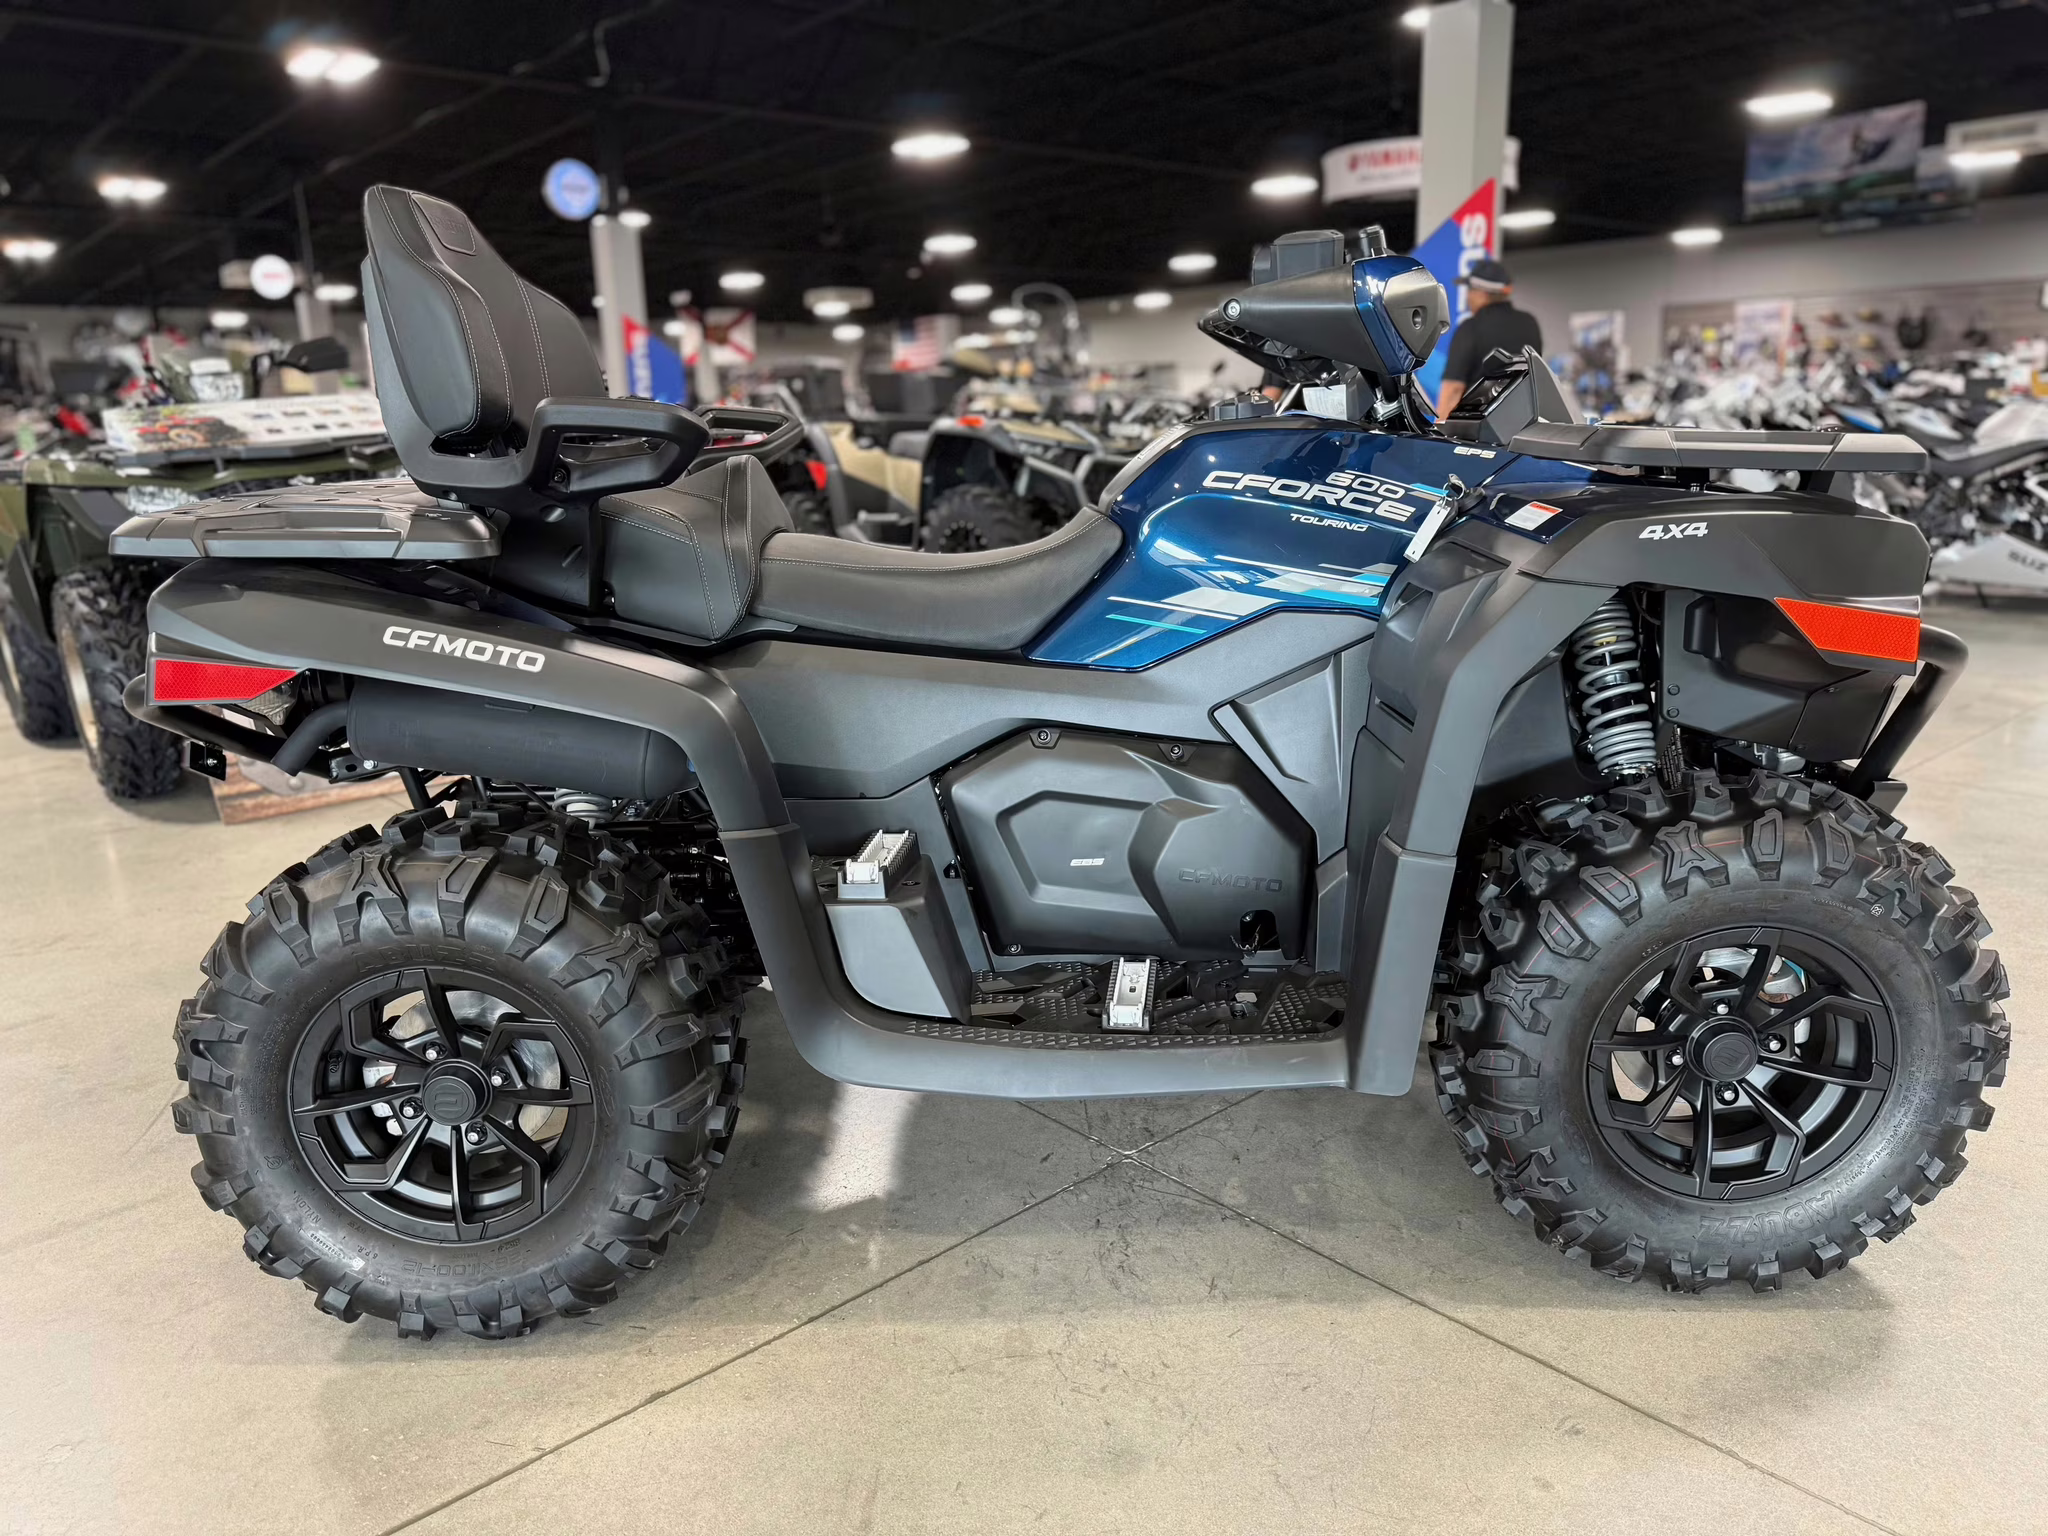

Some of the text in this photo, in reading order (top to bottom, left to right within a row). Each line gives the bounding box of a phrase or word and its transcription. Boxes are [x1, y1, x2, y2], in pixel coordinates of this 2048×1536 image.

[1453, 446, 1497, 459] EPS
[1202, 470, 1417, 523] CFORCE
[1326, 470, 1406, 499] 600
[1289, 513, 1370, 533] TOURING
[383, 626, 545, 673] CFMOTO
[1178, 868, 1283, 893] CFMOTO
[290, 1193, 322, 1225] NYLON
[1696, 1189, 1839, 1245] ABUZZ
